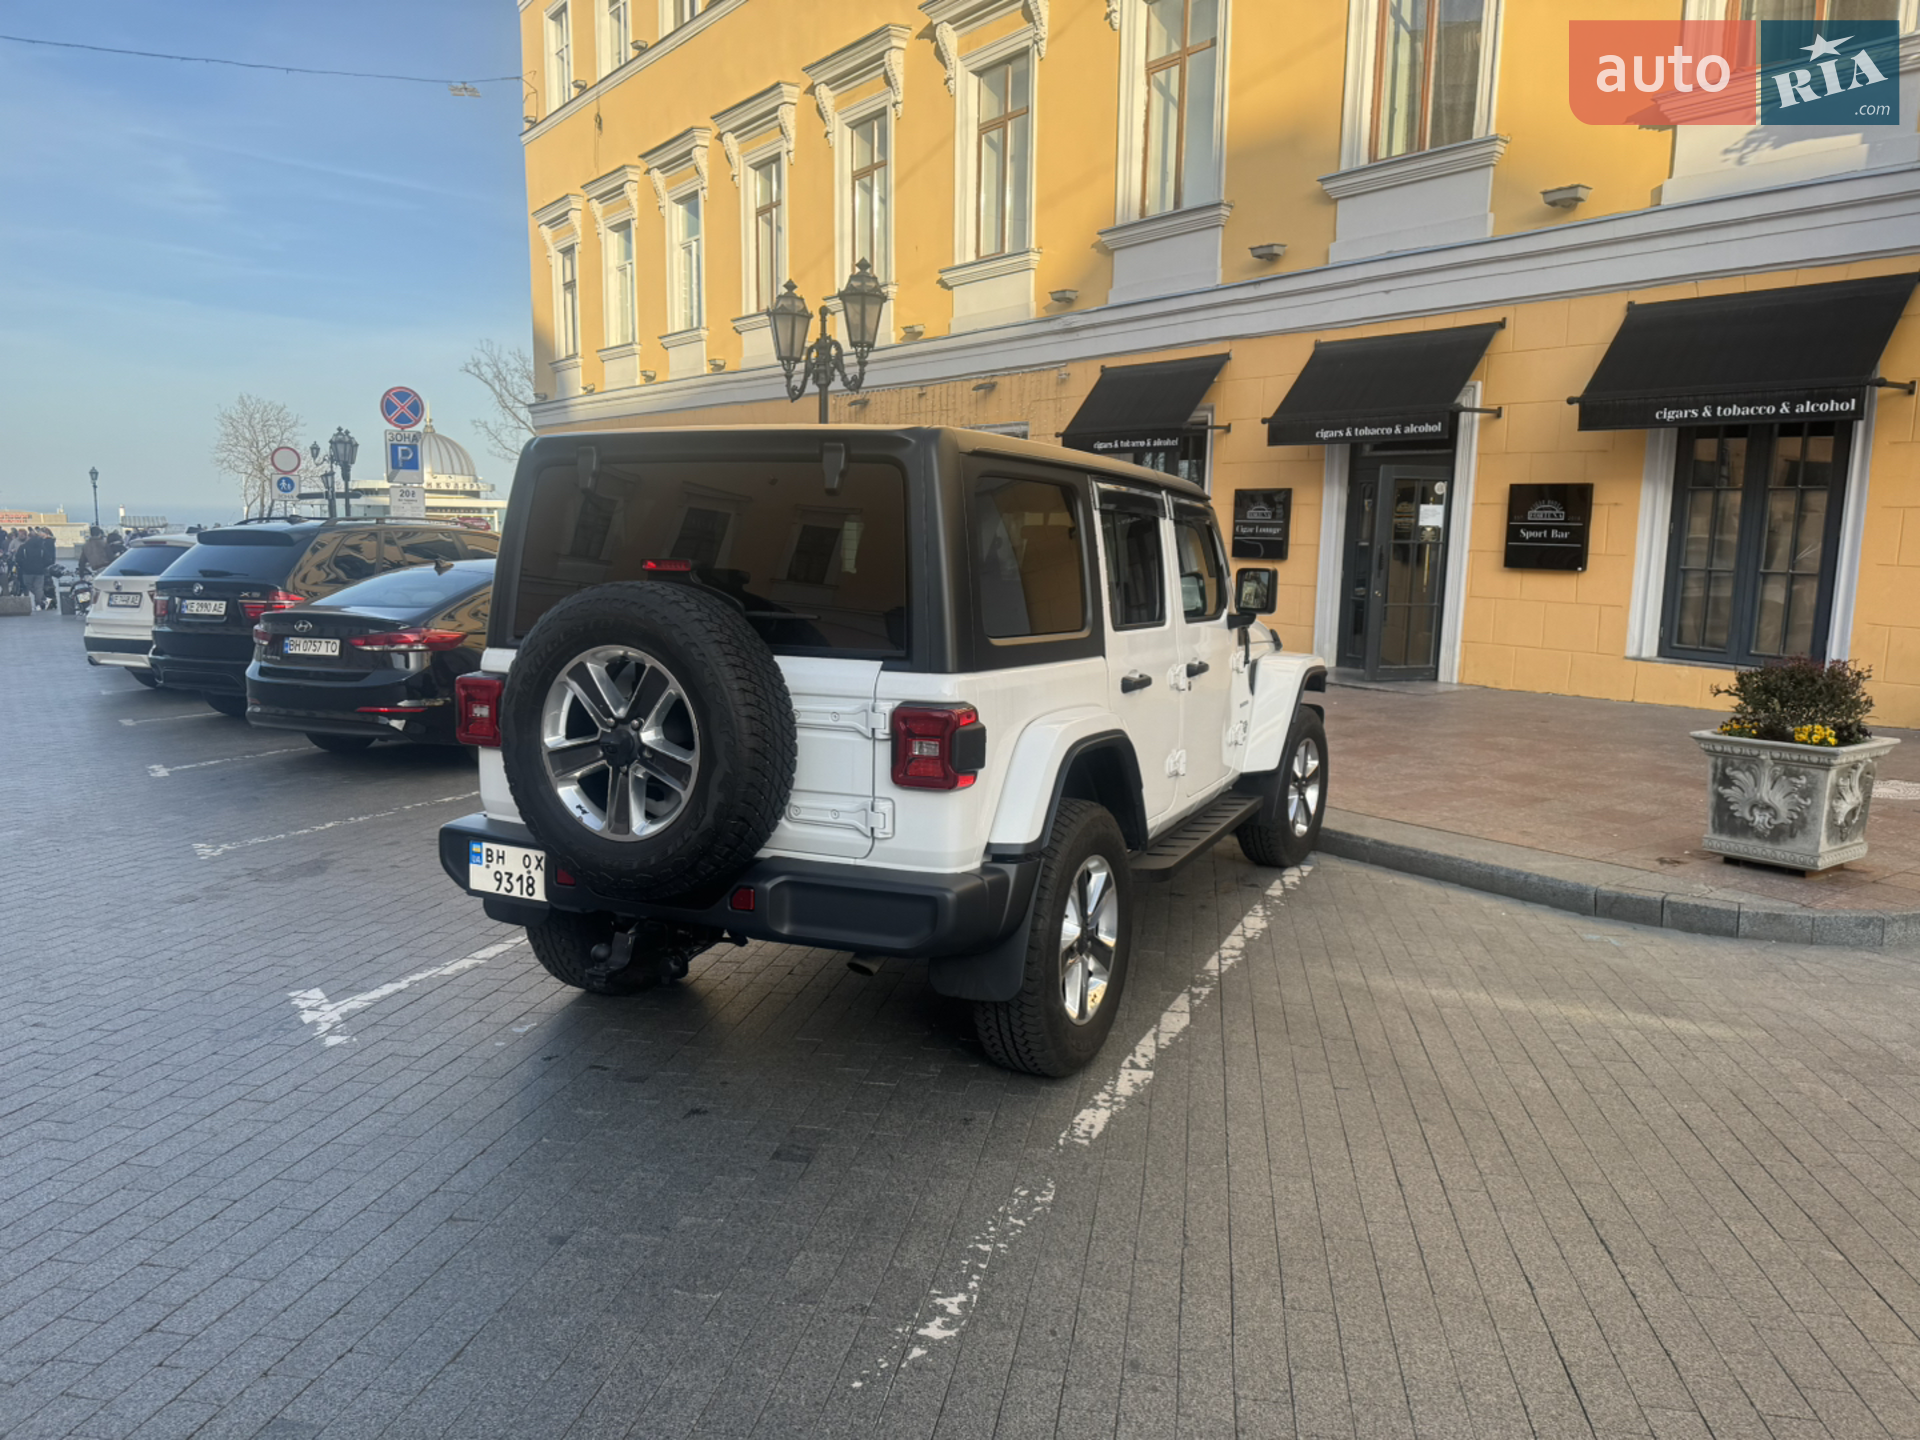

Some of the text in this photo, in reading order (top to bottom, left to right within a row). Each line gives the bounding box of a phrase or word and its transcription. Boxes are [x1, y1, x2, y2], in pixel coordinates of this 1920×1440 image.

[1655, 398, 1856, 422] cigars & tobacco & alcohol
[388, 432, 420, 443] ЗОНА
[1315, 421, 1442, 440] cigars & tobacco & alcohol
[397, 446, 414, 468] P
[1519, 528, 1570, 540] Sport Bar
[213, 602, 224, 613] AE
[288, 639, 338, 653] BH 0757 TO
[485, 847, 505, 865] BH
[522, 854, 544, 872] OX
[493, 870, 536, 897] 9318
